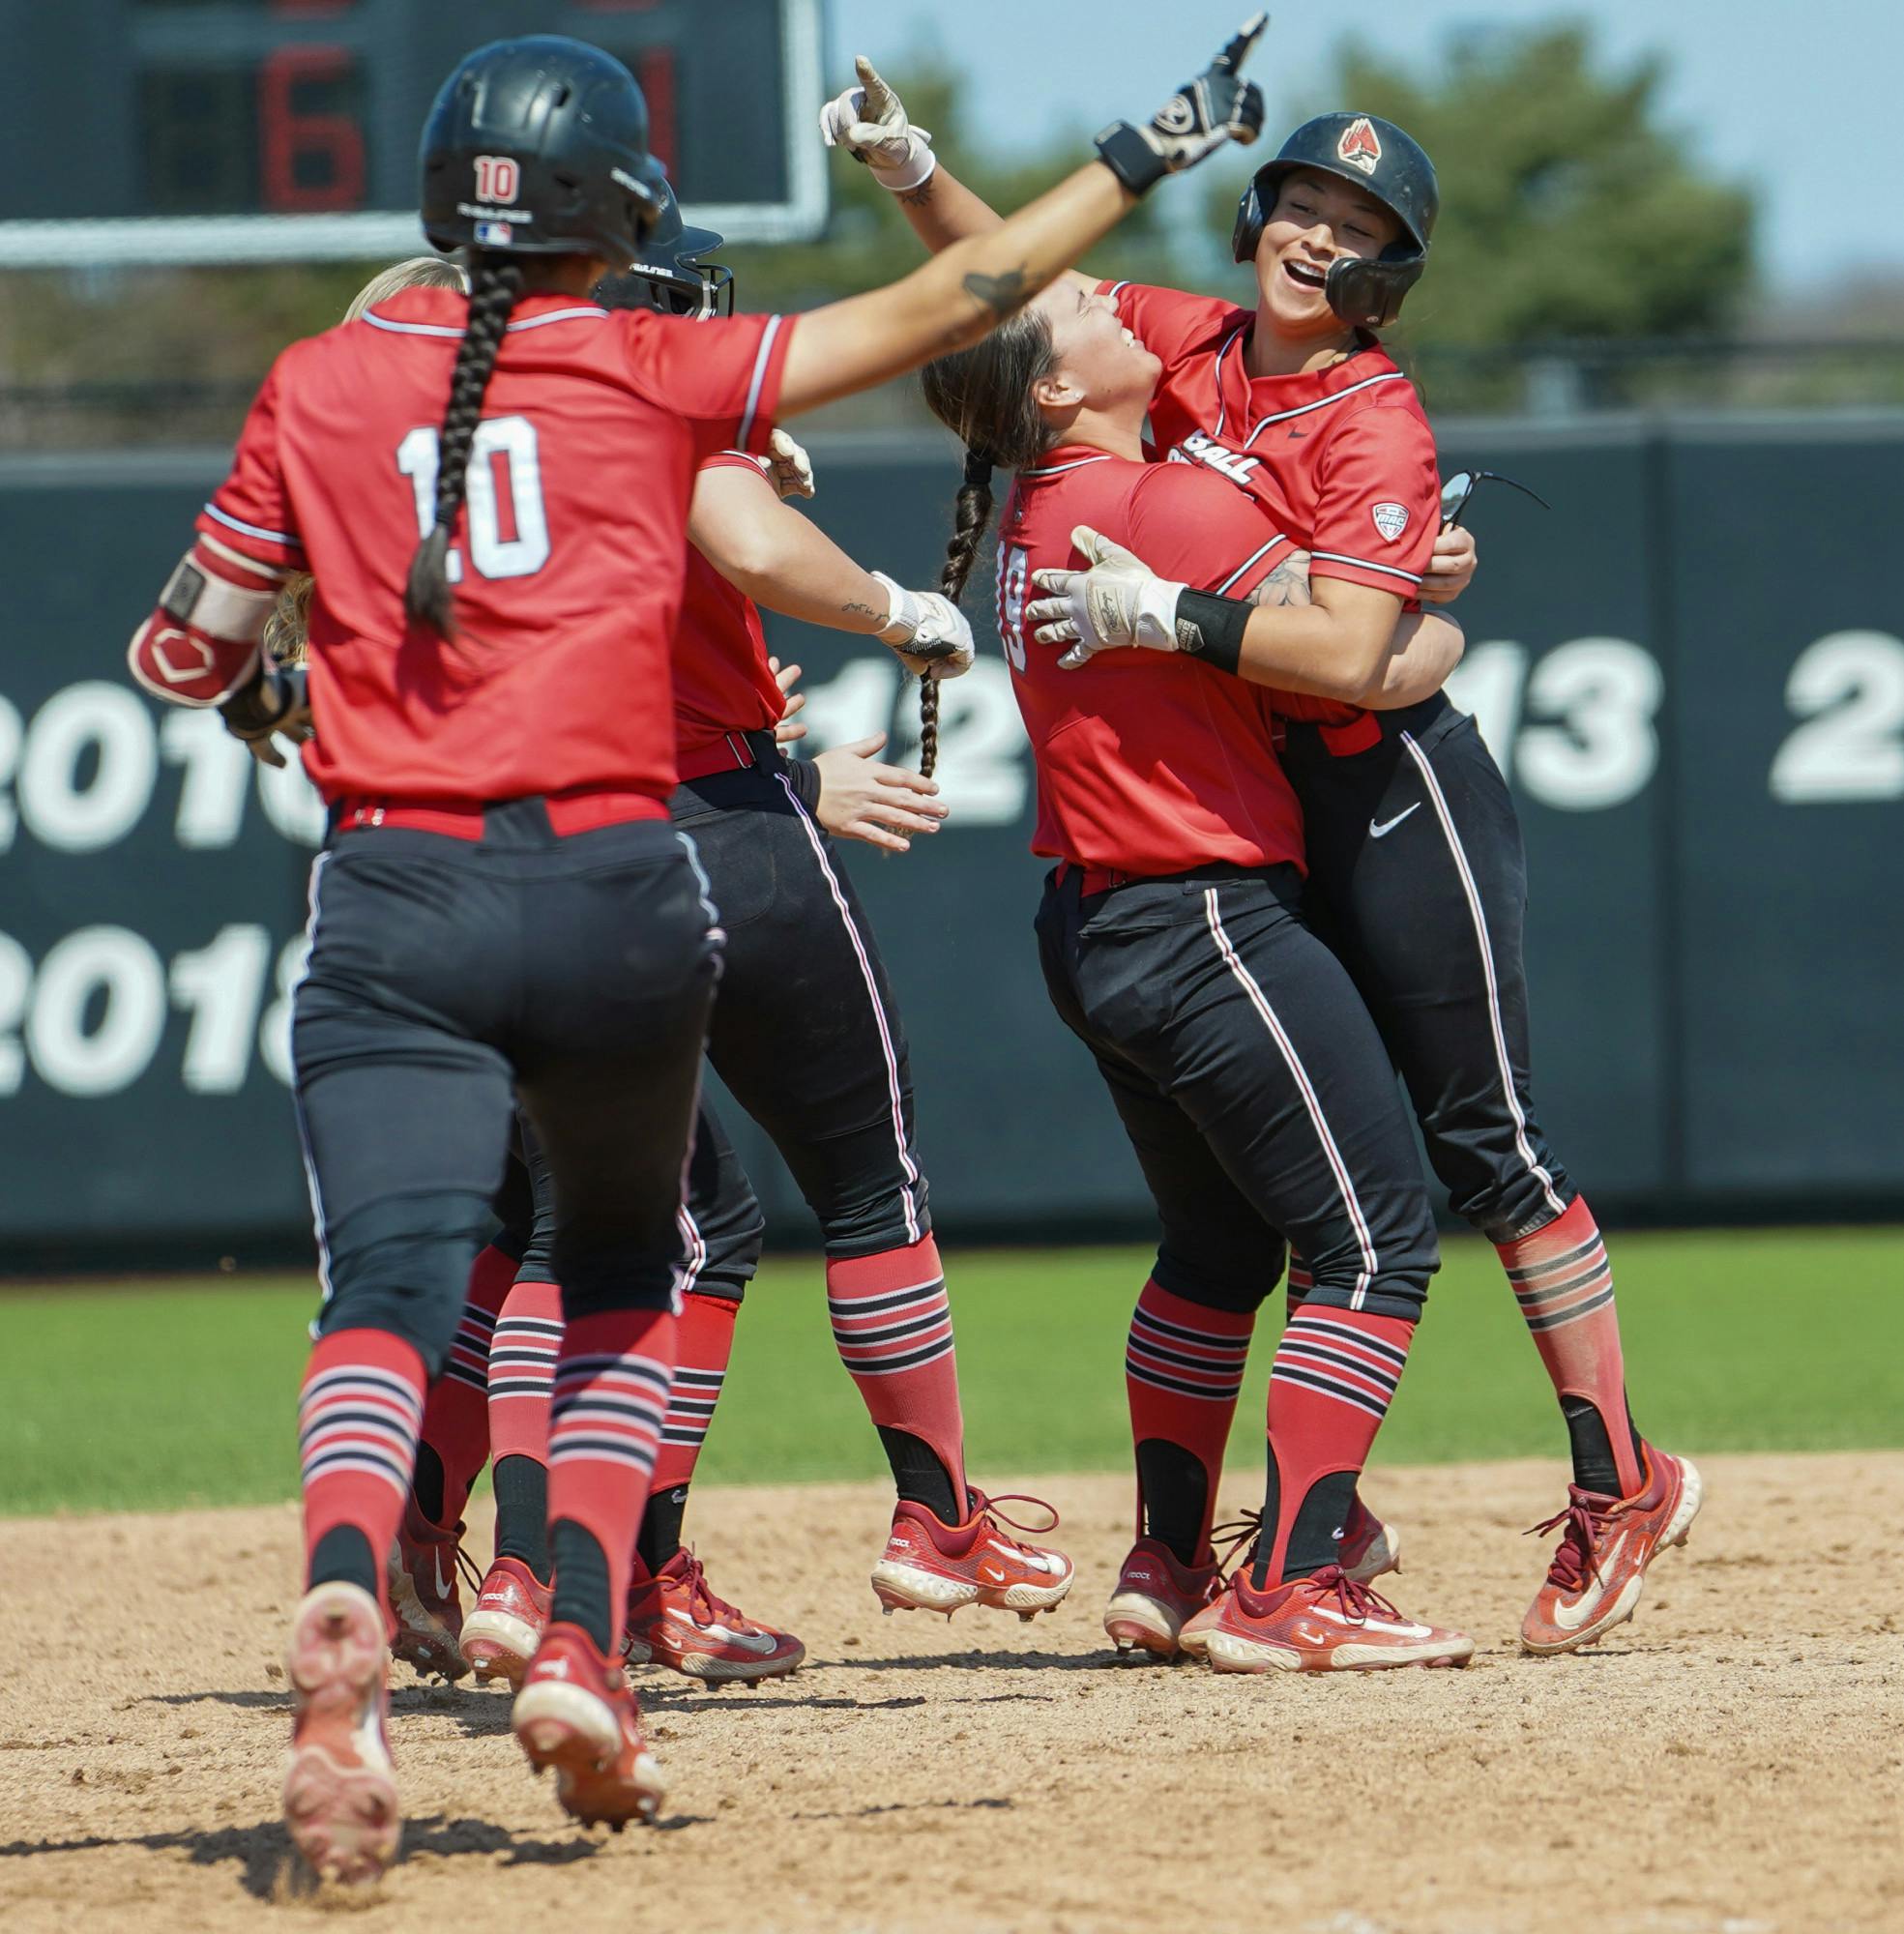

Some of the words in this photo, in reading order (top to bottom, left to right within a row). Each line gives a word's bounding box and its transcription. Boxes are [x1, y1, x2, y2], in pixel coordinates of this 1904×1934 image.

[258, 44, 366, 212] 6
[473, 155, 520, 205] 10
[396, 415, 552, 583] 10
[1182, 427, 1261, 485] BALL
